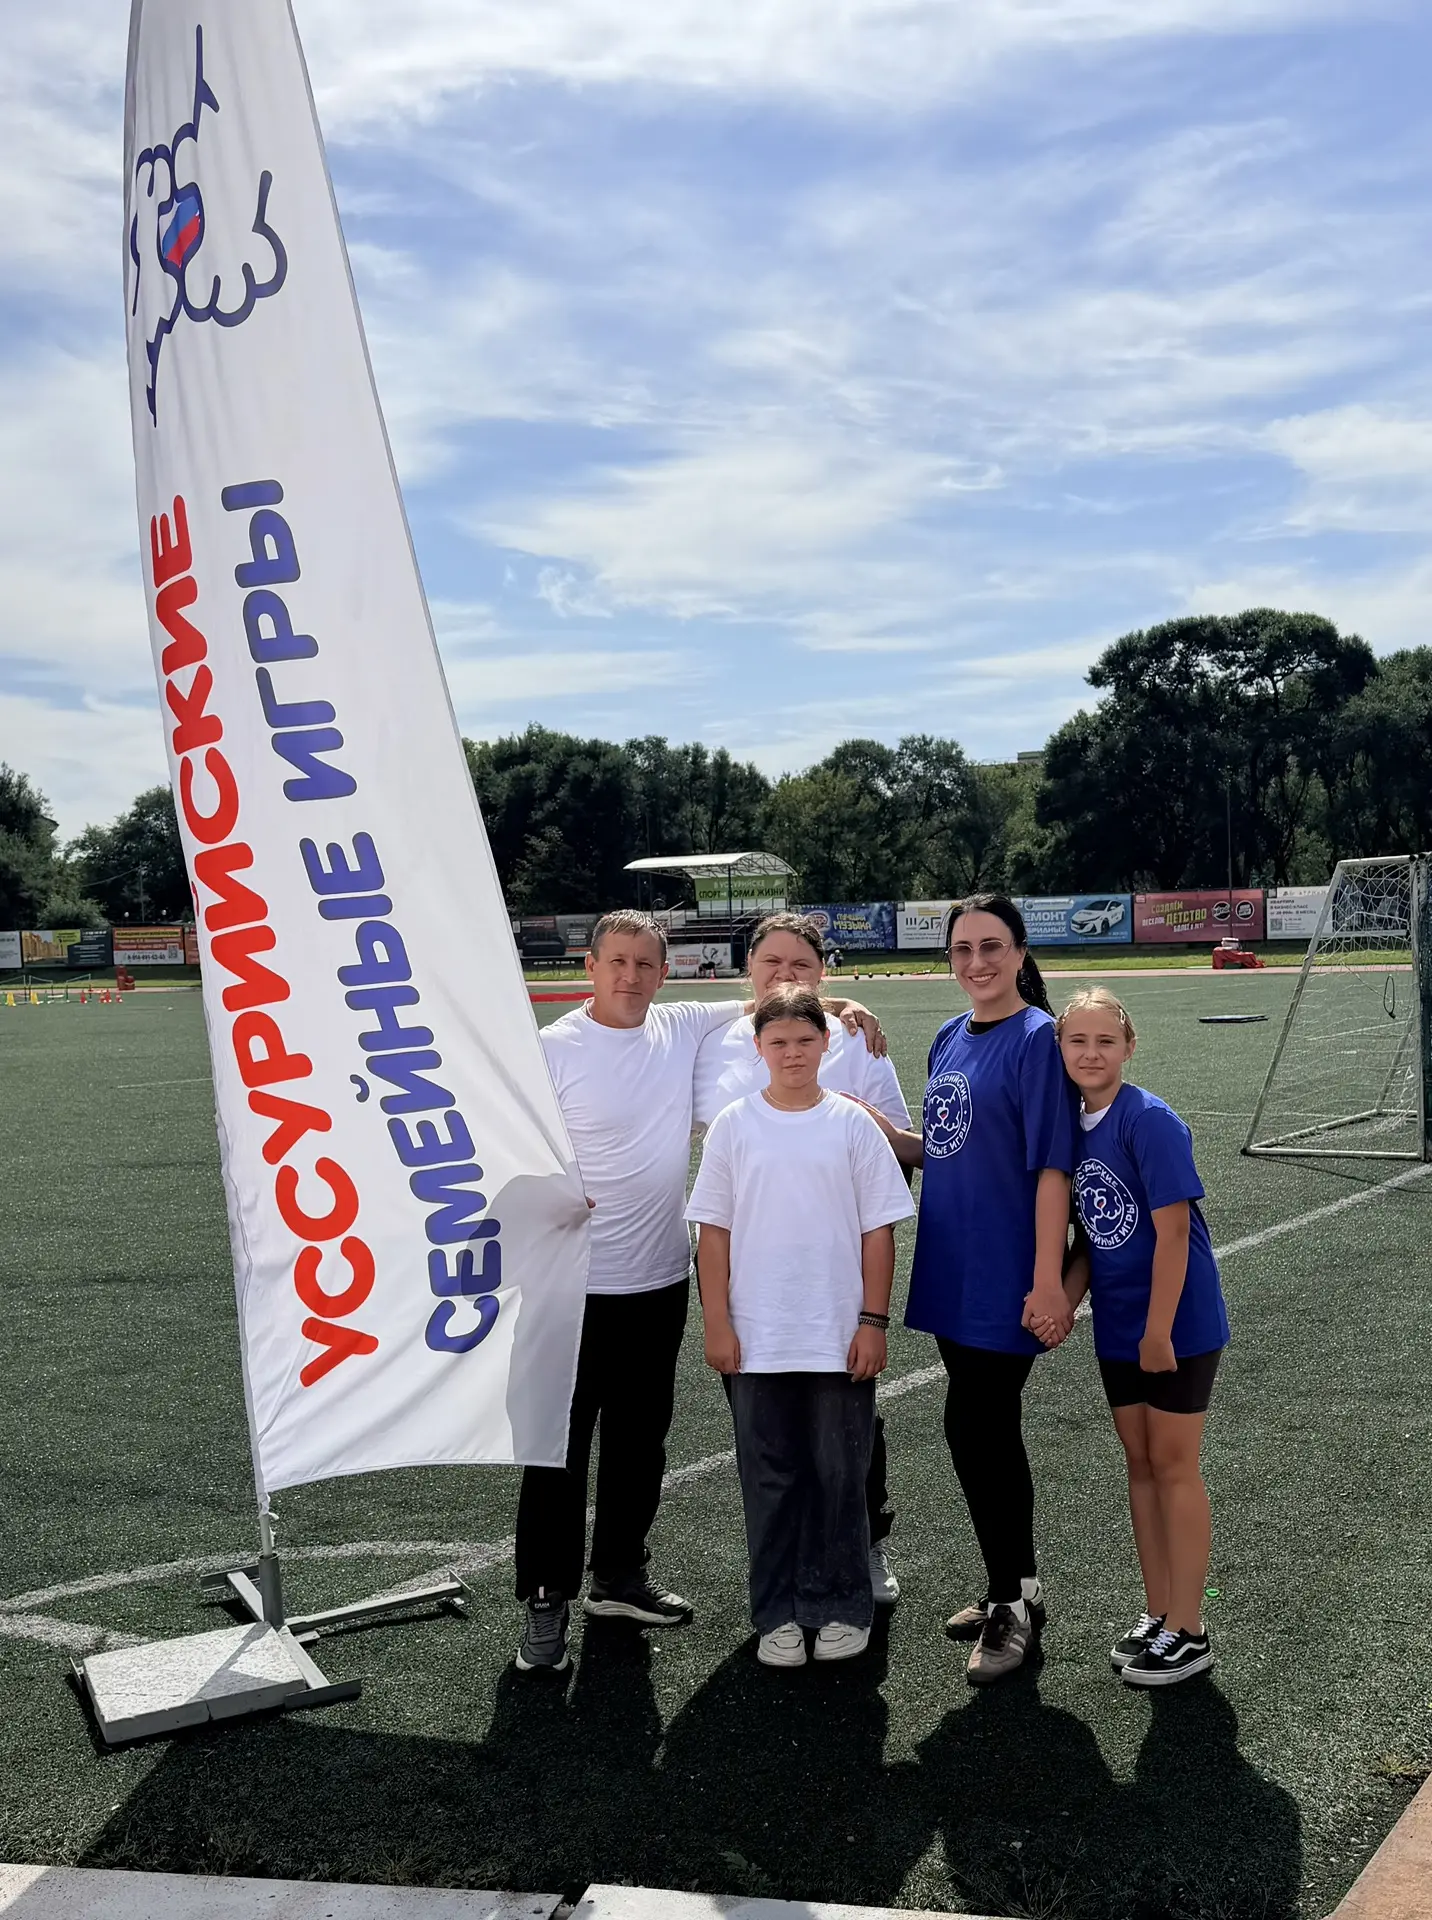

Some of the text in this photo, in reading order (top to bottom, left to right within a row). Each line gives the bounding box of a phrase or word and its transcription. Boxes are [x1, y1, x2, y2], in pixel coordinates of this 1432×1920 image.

[720, 878, 765, 888] УСУРИЙСКЕ
[699, 890, 721, 899] СПОРТ
[728, 889, 755, 898] ОРМА
[757, 887, 784, 897] ЖИЗНИ
[222, 480, 503, 1355] СЕМЕЙНЫЕ ИГРЫ
[833, 920, 872, 930] МУЗЫКА
[1023, 911, 1067, 921] ЕМОНТ
[1165, 908, 1207, 926] ДЕТСТВО
[151, 495, 379, 1388] УССУРИЙСКИЕ
[949, 1121, 967, 1150] ИГРЫ
[1118, 1203, 1136, 1238] ИГРЫ
